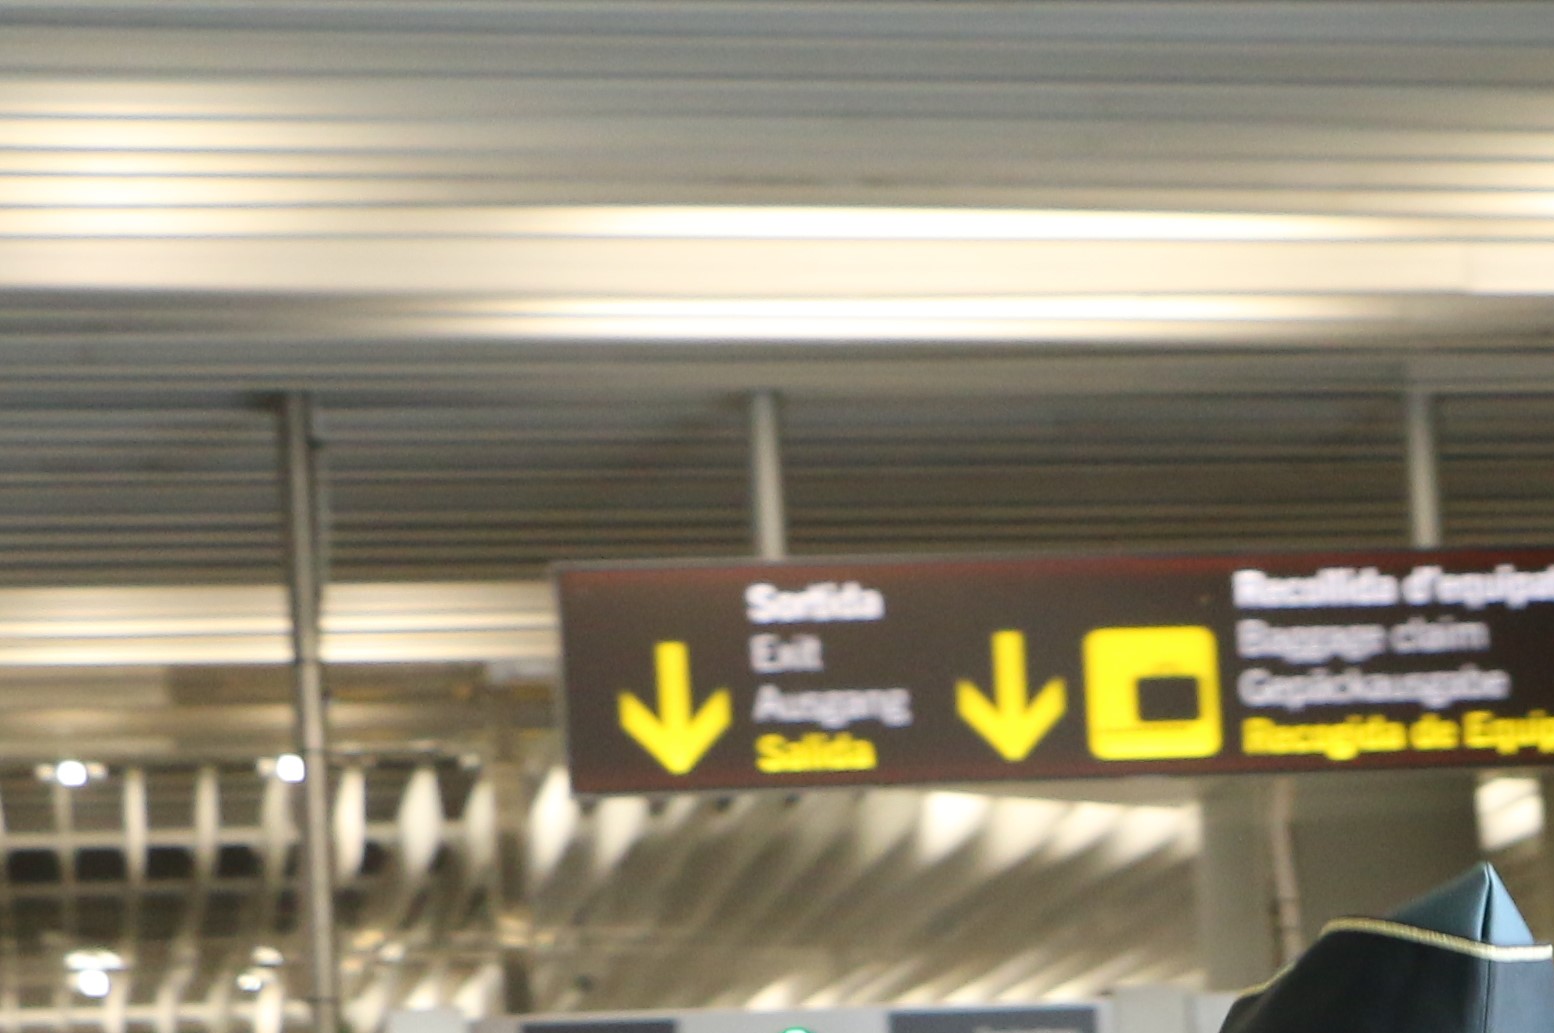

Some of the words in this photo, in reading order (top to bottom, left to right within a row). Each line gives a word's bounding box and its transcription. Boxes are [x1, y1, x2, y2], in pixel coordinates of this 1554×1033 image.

[745, 580, 888, 624] Sortida
[1232, 567, 1398, 609] Recollida
[750, 633, 824, 673] Exit
[1236, 618, 1386, 664] Baggage
[1389, 616, 1491, 654] claim
[753, 684, 914, 729] Ausgang
[755, 731, 878, 773] Salida
[1242, 713, 1408, 760] Recogida
[1409, 711, 1460, 750] de
